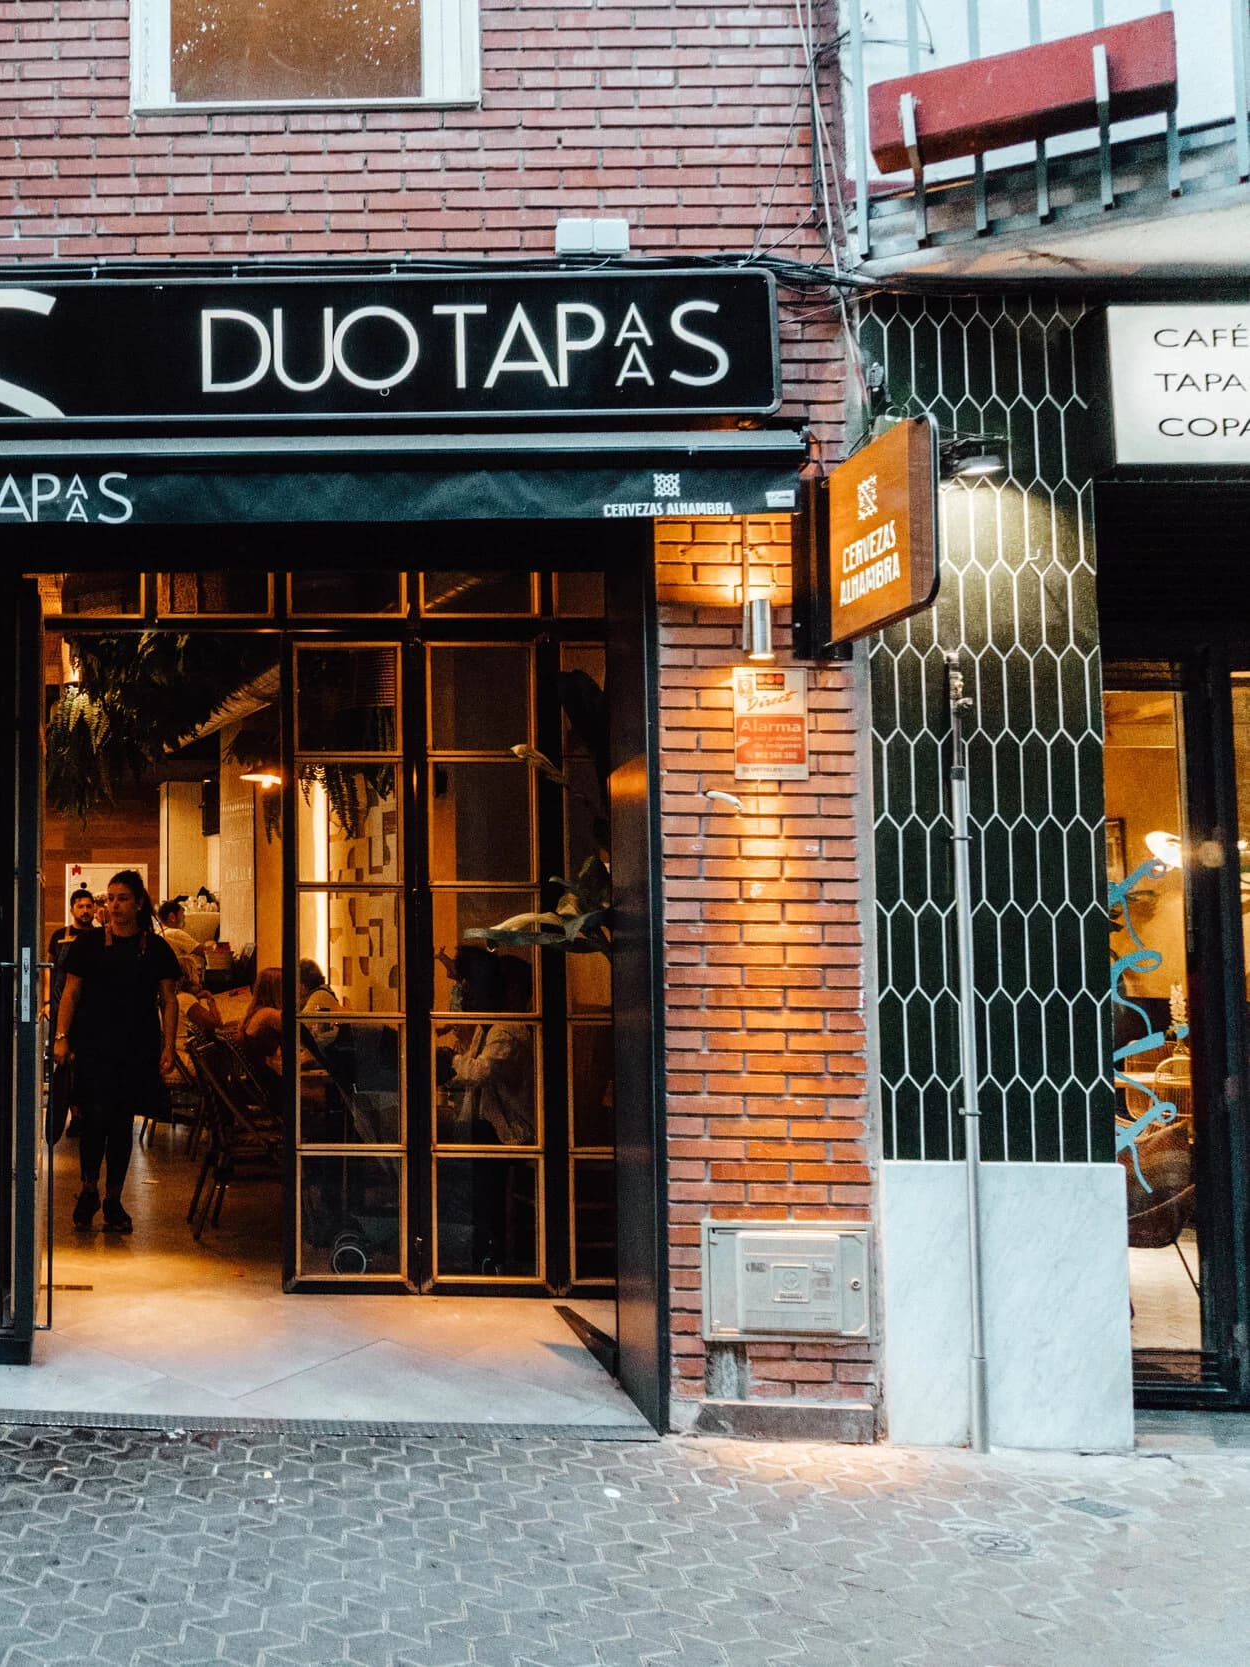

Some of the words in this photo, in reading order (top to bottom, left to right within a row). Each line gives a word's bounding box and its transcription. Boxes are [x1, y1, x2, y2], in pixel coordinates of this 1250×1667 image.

[201, 304, 419, 392] DUO
[1153, 323, 1249, 348] CAFÉ
[1153, 373, 1247, 392] TAPA
[603, 502, 664, 518] CERVEZAS
[666, 501, 733, 516] ALHAMBRA
[842, 519, 896, 574] CERVEZAS
[839, 552, 901, 608] ALHAMBRA
[740, 719, 802, 734] Alarma
